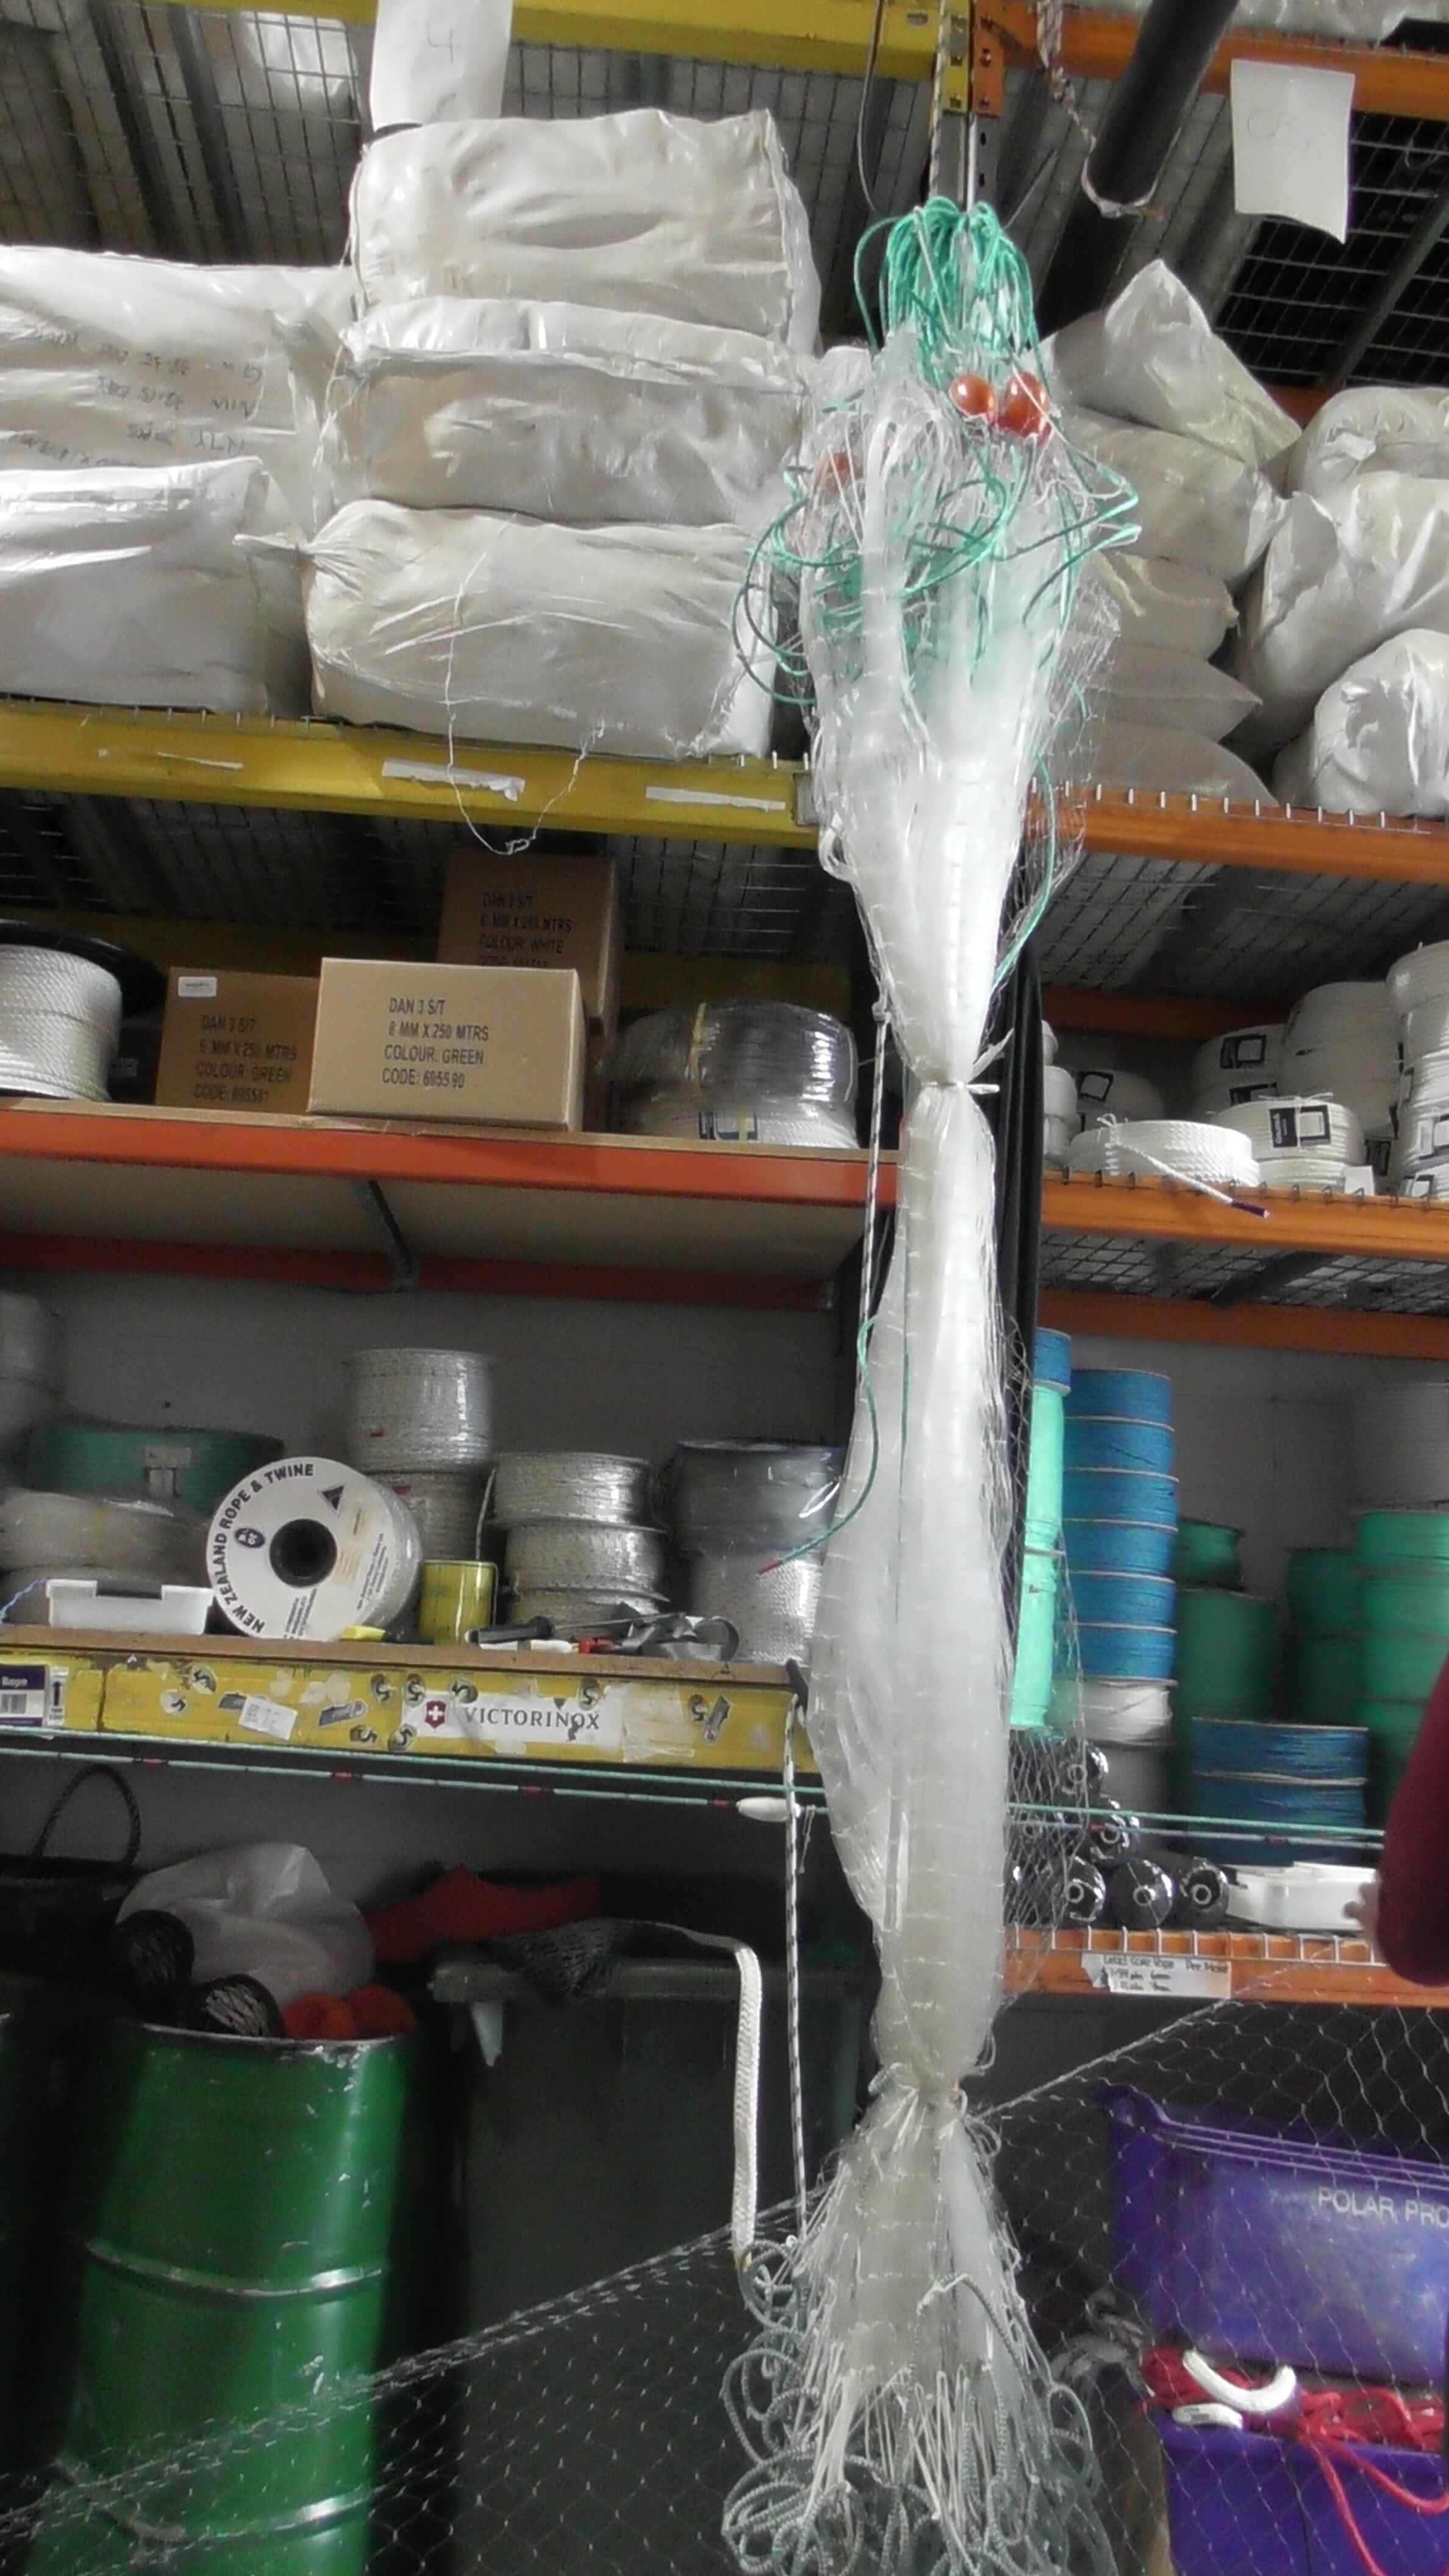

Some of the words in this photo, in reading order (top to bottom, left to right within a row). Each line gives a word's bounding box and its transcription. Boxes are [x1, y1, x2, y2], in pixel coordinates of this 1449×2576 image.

[389, 998, 415, 1014] DAN
[428, 999, 446, 1015] S/T
[400, 1021, 419, 1036] MM
[423, 1022, 430, 1038] X
[434, 1023, 452, 1039] 250
[456, 1025, 489, 1041] MTRS
[442, 1048, 485, 1065] GREEN
[252, 1065, 292, 1083] GREEN
[264, 1464, 313, 1484] TWINE
[250, 1479, 263, 1494] &
[218, 1490, 251, 1530] ROPE
[213, 1533, 238, 1605] ZEALAND
[232, 1605, 265, 1634] NEW
[464, 1707, 600, 1731] VICTORINOX
[1318, 2187, 1398, 2225] POLAR
